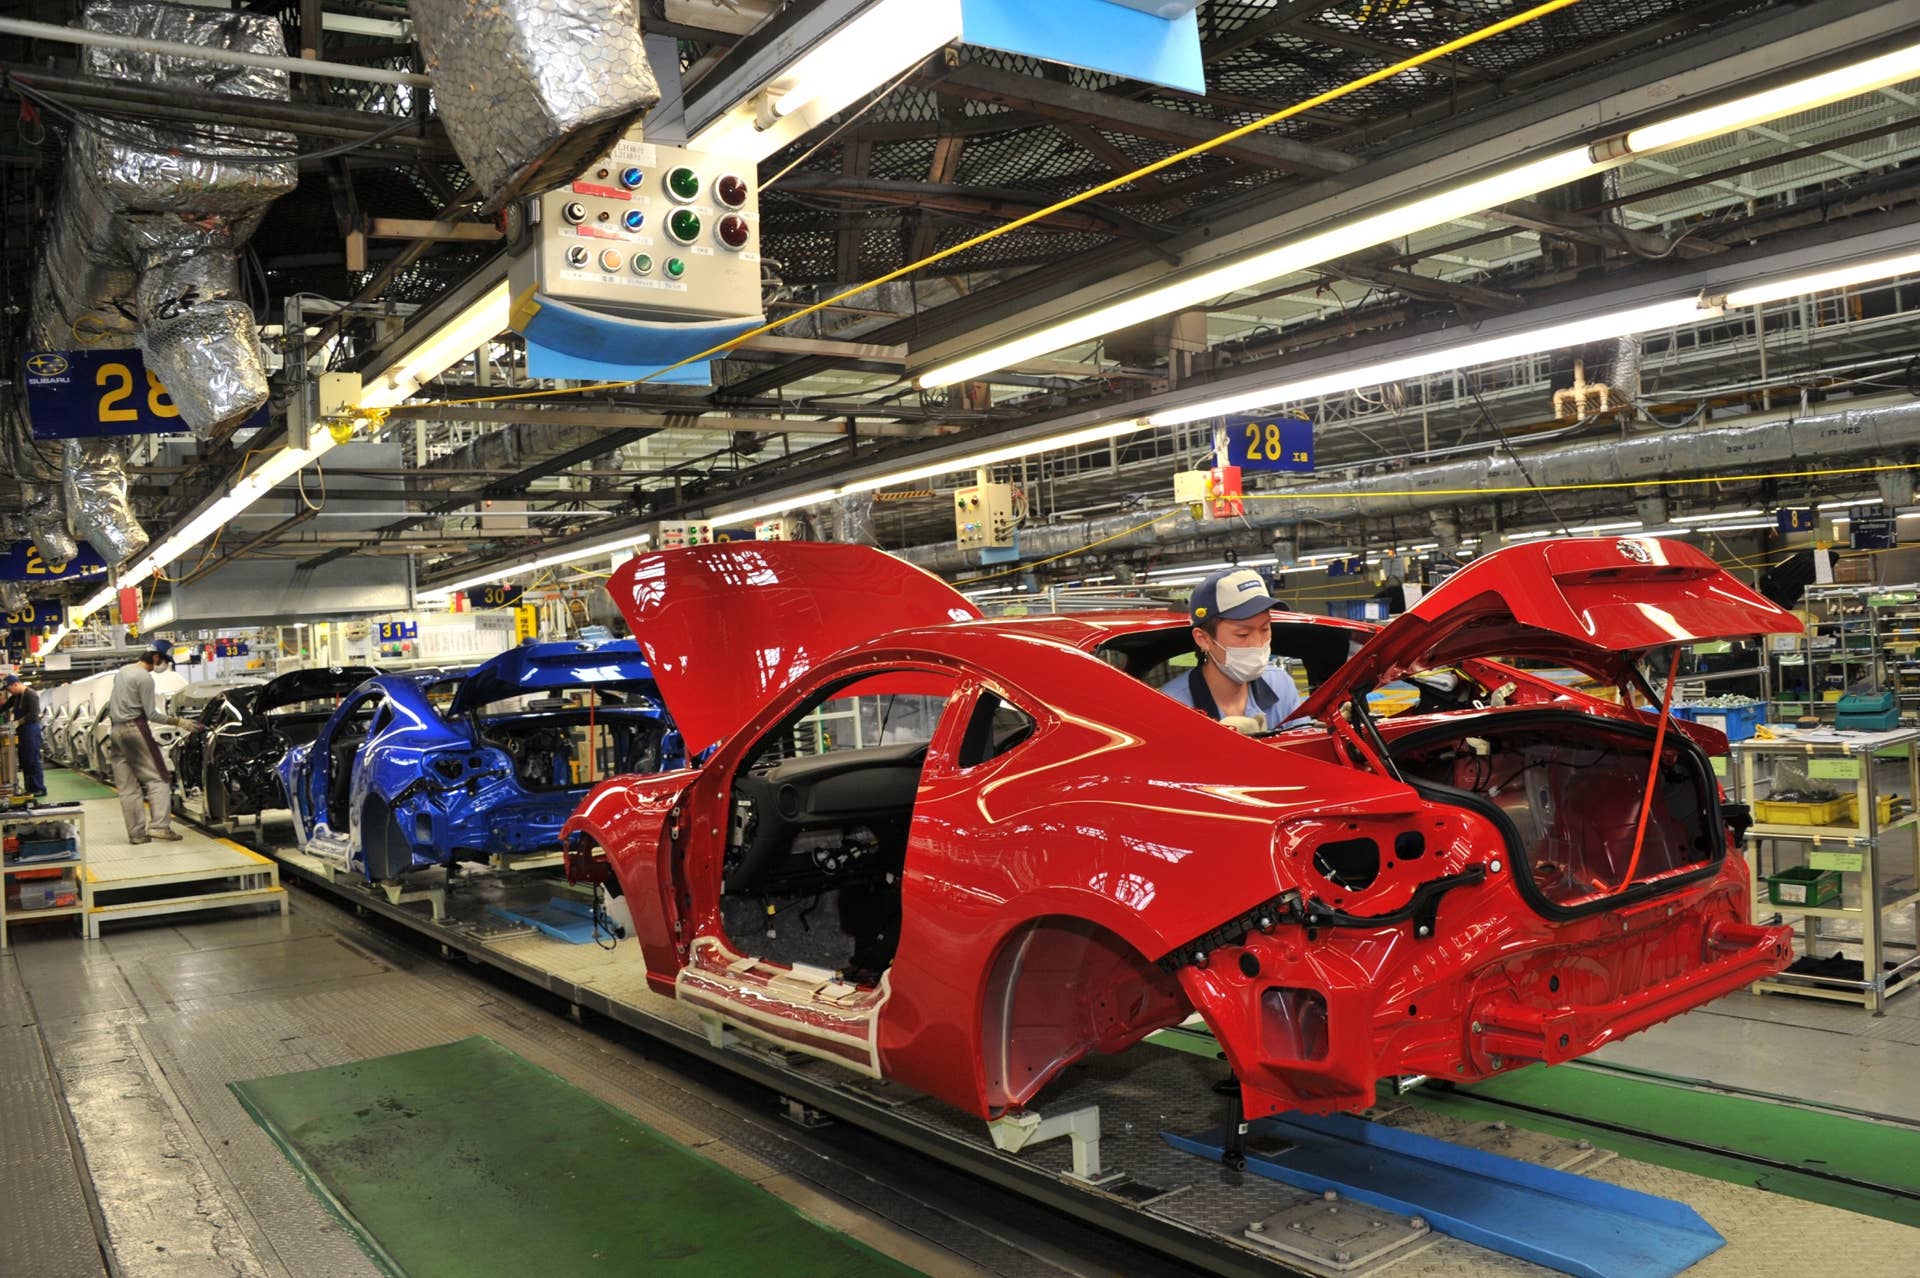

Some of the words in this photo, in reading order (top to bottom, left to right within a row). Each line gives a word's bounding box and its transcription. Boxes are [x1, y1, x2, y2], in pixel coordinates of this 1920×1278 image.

[28, 377, 70, 385] SUBARU
[1245, 423, 1281, 461] 28
[1791, 510, 1799, 529] 8
[484, 587, 505, 604] 30
[382, 623, 402, 638] 31
[226, 646, 239, 656] 33
